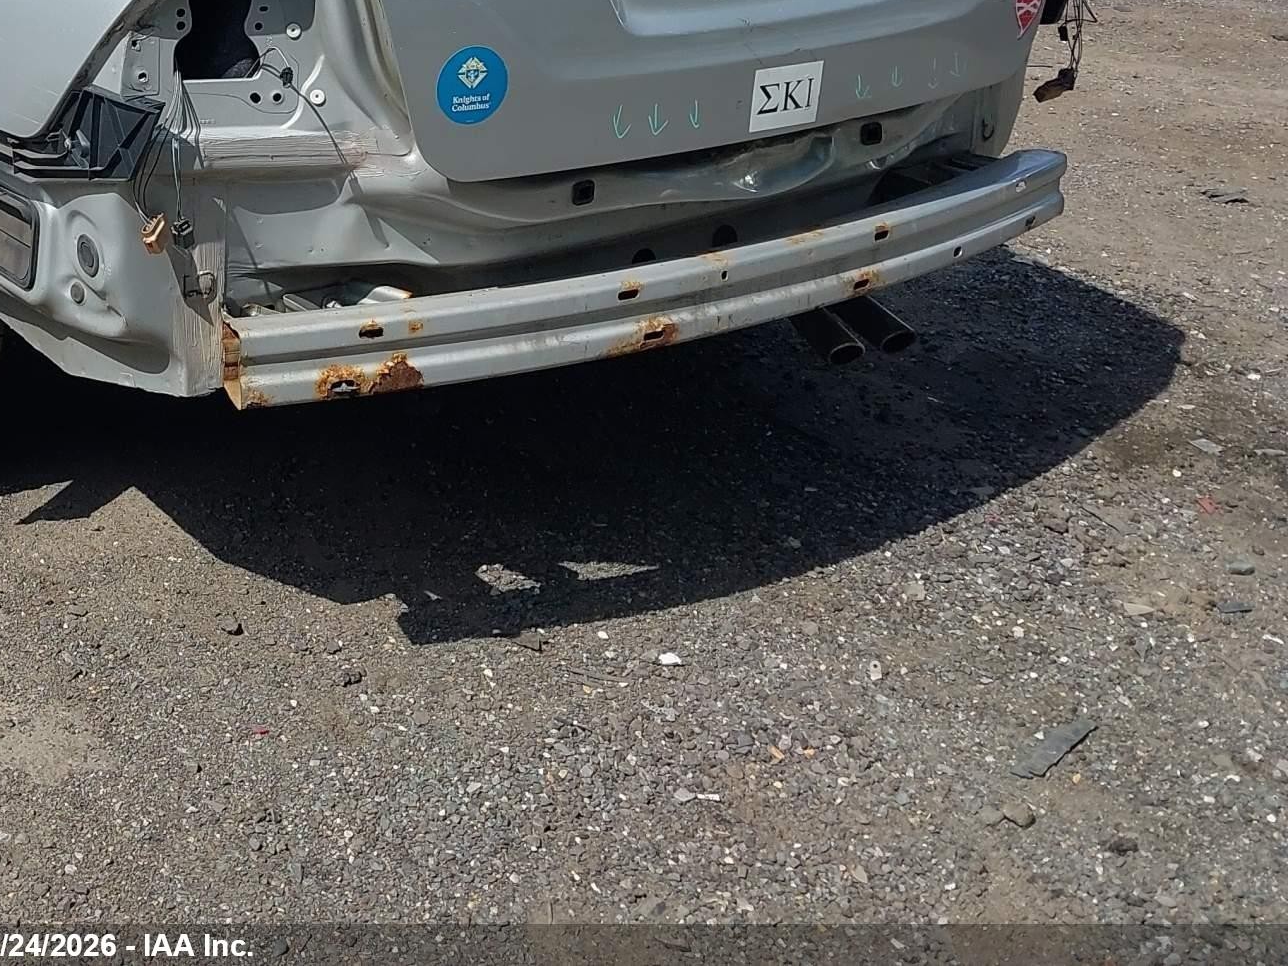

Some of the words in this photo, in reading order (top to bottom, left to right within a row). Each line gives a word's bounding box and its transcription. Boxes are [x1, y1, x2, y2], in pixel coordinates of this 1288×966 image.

[452, 94, 481, 105] Knights
[482, 93, 491, 102] of
[451, 102, 490, 112] Columbus
